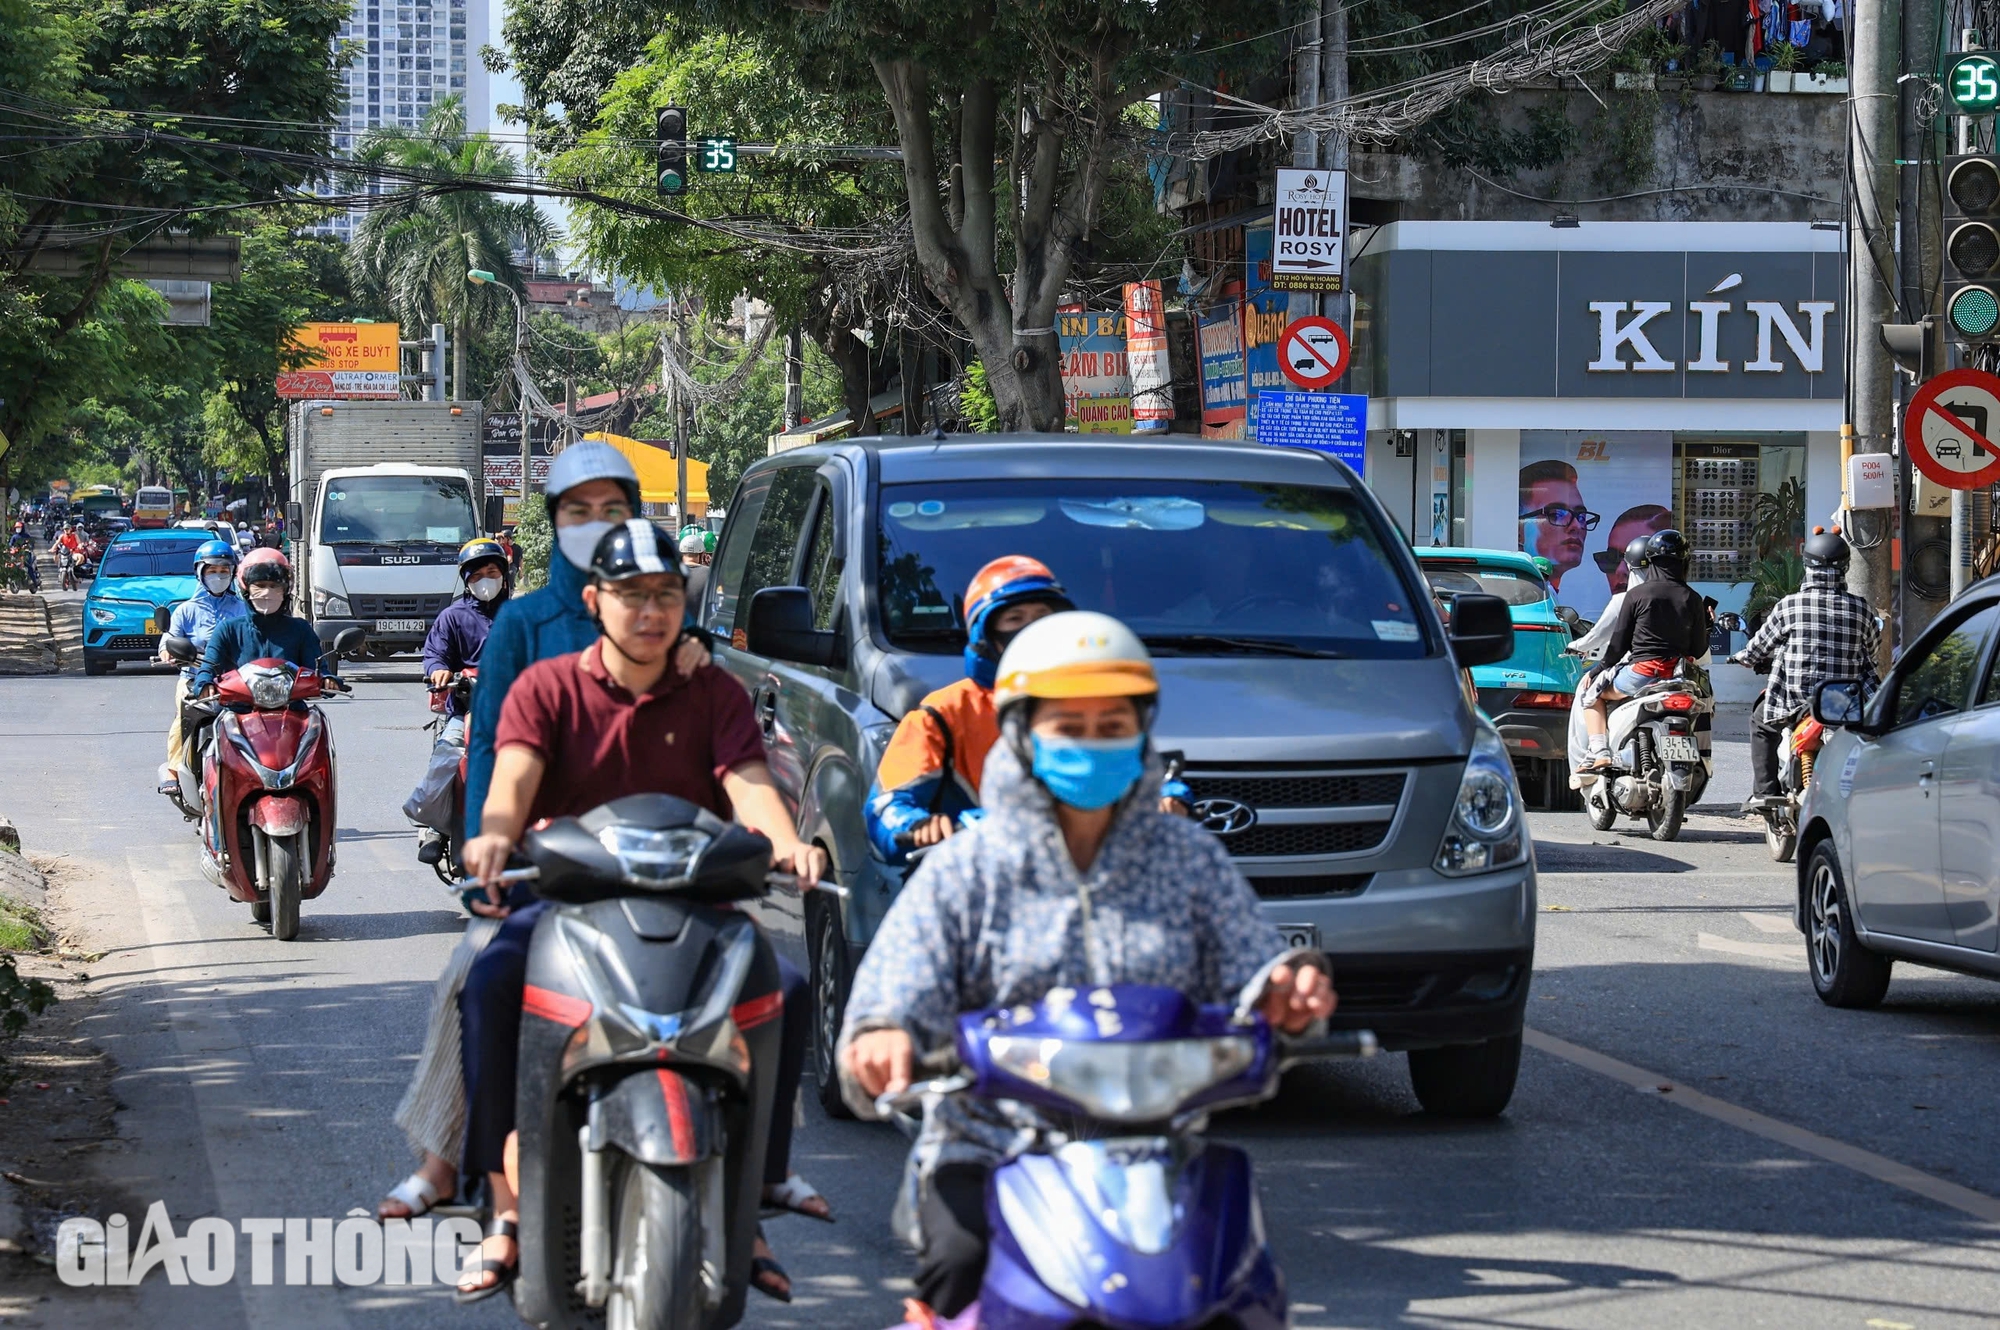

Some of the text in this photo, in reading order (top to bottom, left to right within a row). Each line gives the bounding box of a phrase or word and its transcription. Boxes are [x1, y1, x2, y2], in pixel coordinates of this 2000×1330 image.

[1957, 64, 1997, 101] 35
[706, 139, 733, 168] 35
[1278, 207, 1340, 238] HOTEL
[1280, 241, 1336, 256] ROSY
[1310, 282, 1324, 290] 832
[1588, 272, 1835, 372] KÍN
[1061, 316, 1088, 336] IN
[1097, 316, 1127, 340] BẠ
[346, 346, 358, 357] XE
[363, 344, 390, 358] BUÝT
[339, 360, 359, 368] STOP
[334, 372, 398, 381] ULTRAFORMER
[1080, 402, 1128, 424] QUẢNG CÁO
[1712, 446, 1732, 454] Dior
[1862, 462, 1880, 470] P004
[1863, 472, 1884, 480] 500/H
[380, 556, 420, 564] ISUZU
[1666, 737, 1692, 748] 34-E1
[1663, 749, 1698, 760] 324.14
